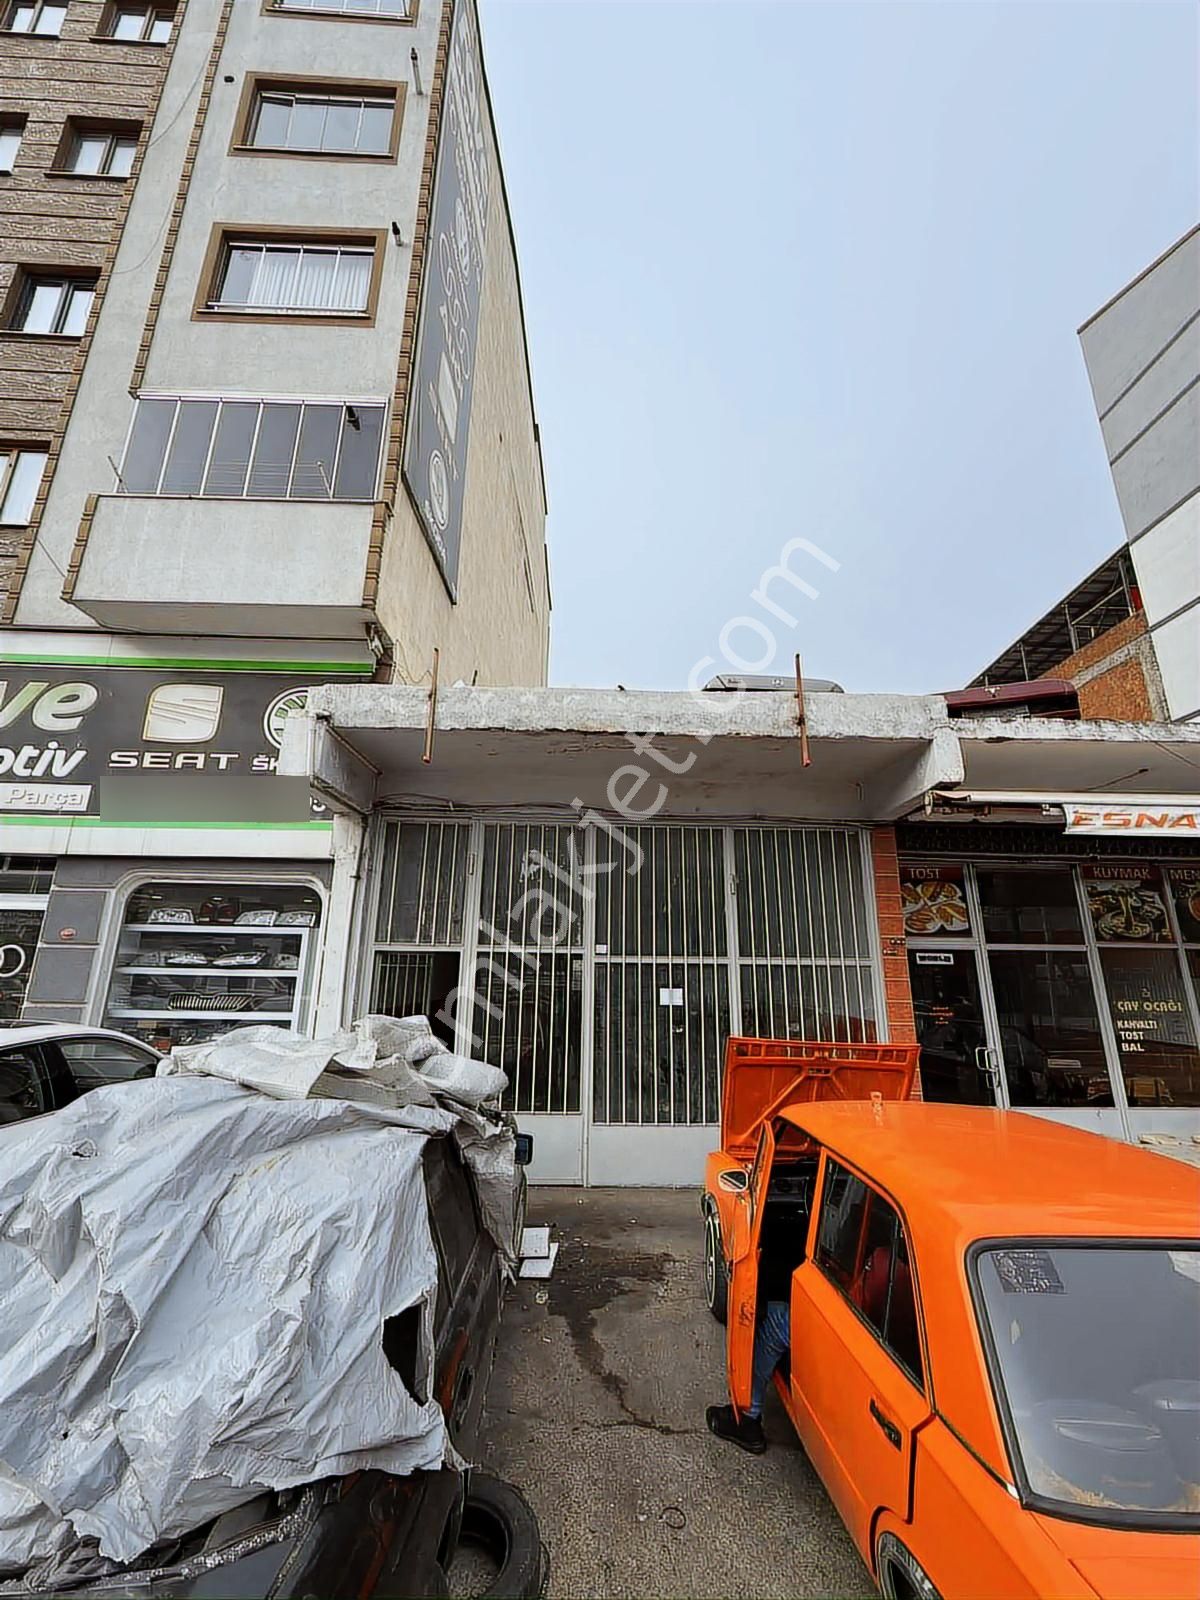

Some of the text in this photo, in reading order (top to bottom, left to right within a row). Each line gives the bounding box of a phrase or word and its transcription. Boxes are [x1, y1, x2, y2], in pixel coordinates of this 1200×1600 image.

[108, 751, 240, 770] SEAT
[5, 789, 84, 811] Parça
[1072, 810, 1198, 828] ESNA
[909, 868, 941, 879] TOST
[1092, 867, 1151, 879] KUYMAK
[1117, 1020, 1157, 1029] KAHVALTI
[1119, 1031, 1144, 1040] TOST
[1121, 1042, 1145, 1052] BAL
